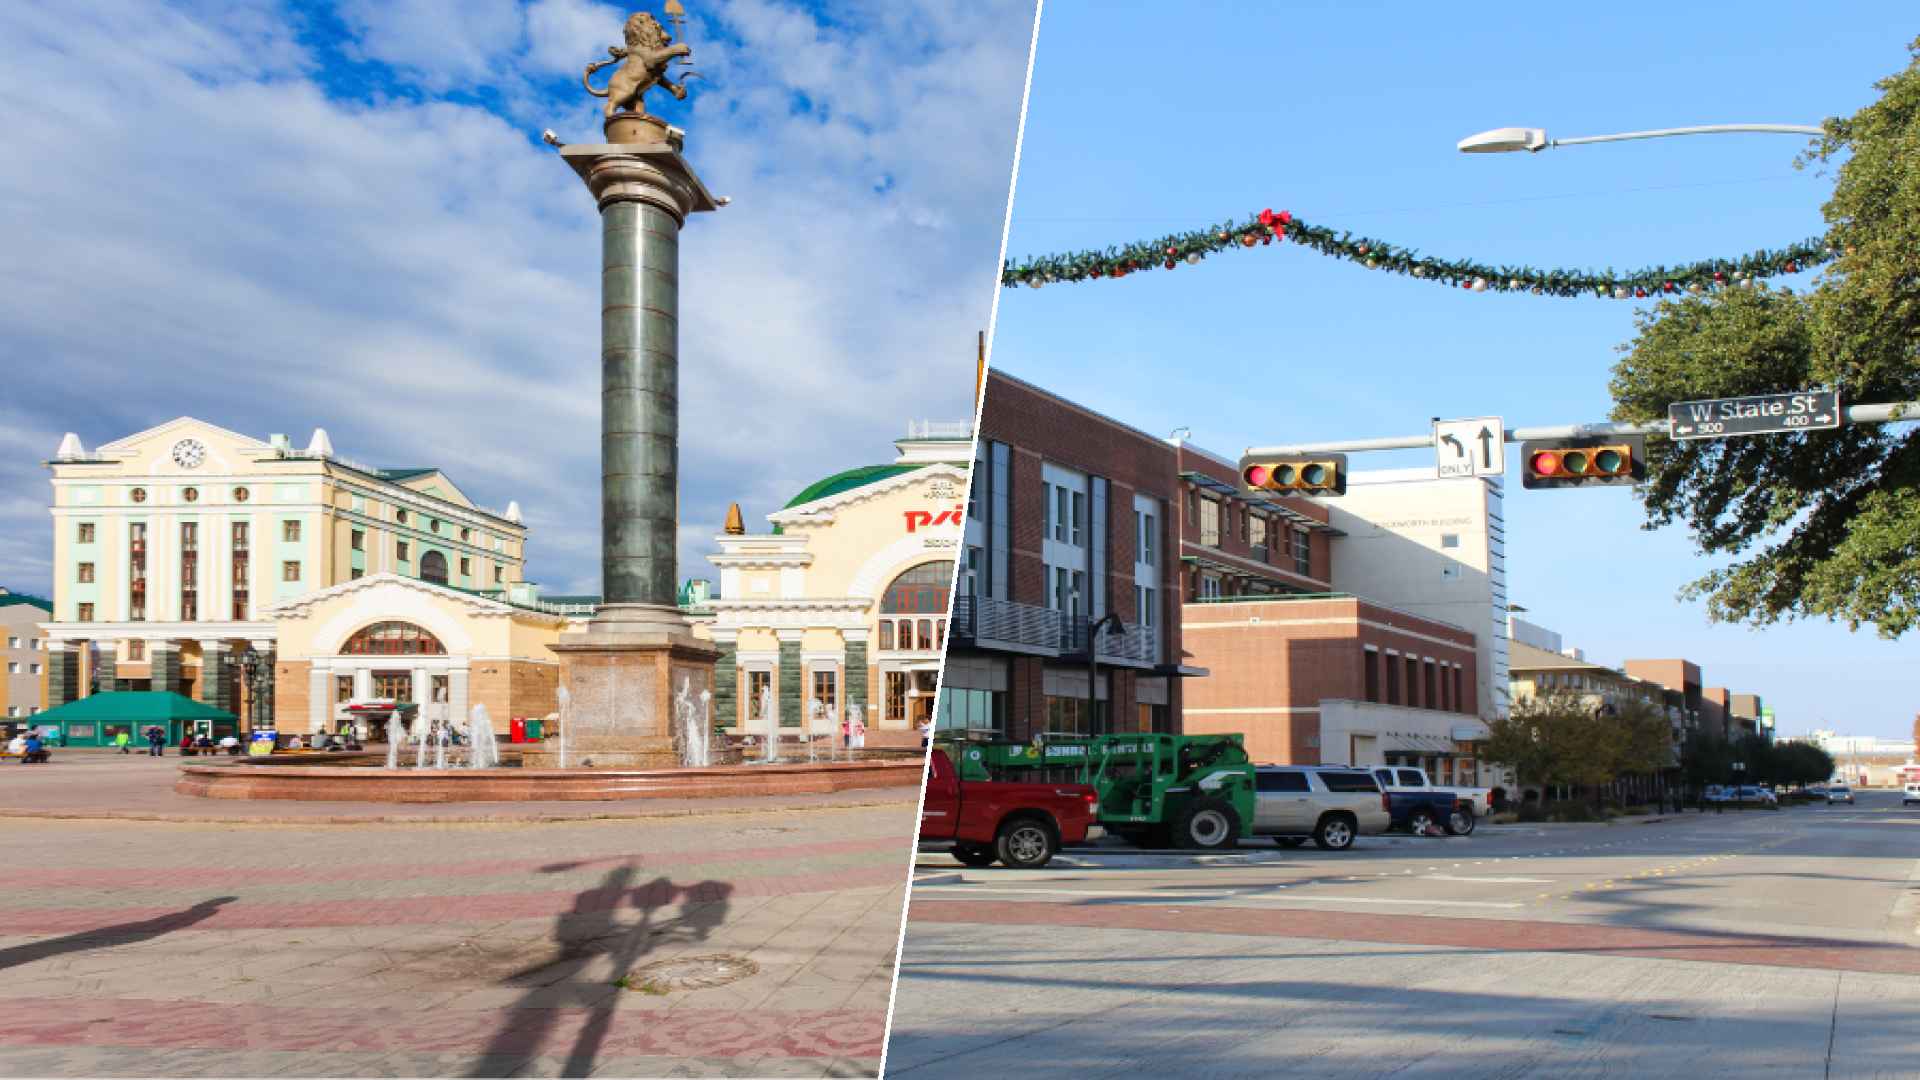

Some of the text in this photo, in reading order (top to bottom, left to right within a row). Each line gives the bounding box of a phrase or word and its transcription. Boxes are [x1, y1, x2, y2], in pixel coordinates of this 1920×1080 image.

[1690, 396, 1817, 422] W State St
[1783, 415, 1809, 426] 400
[1440, 463, 1471, 475] ONLY
